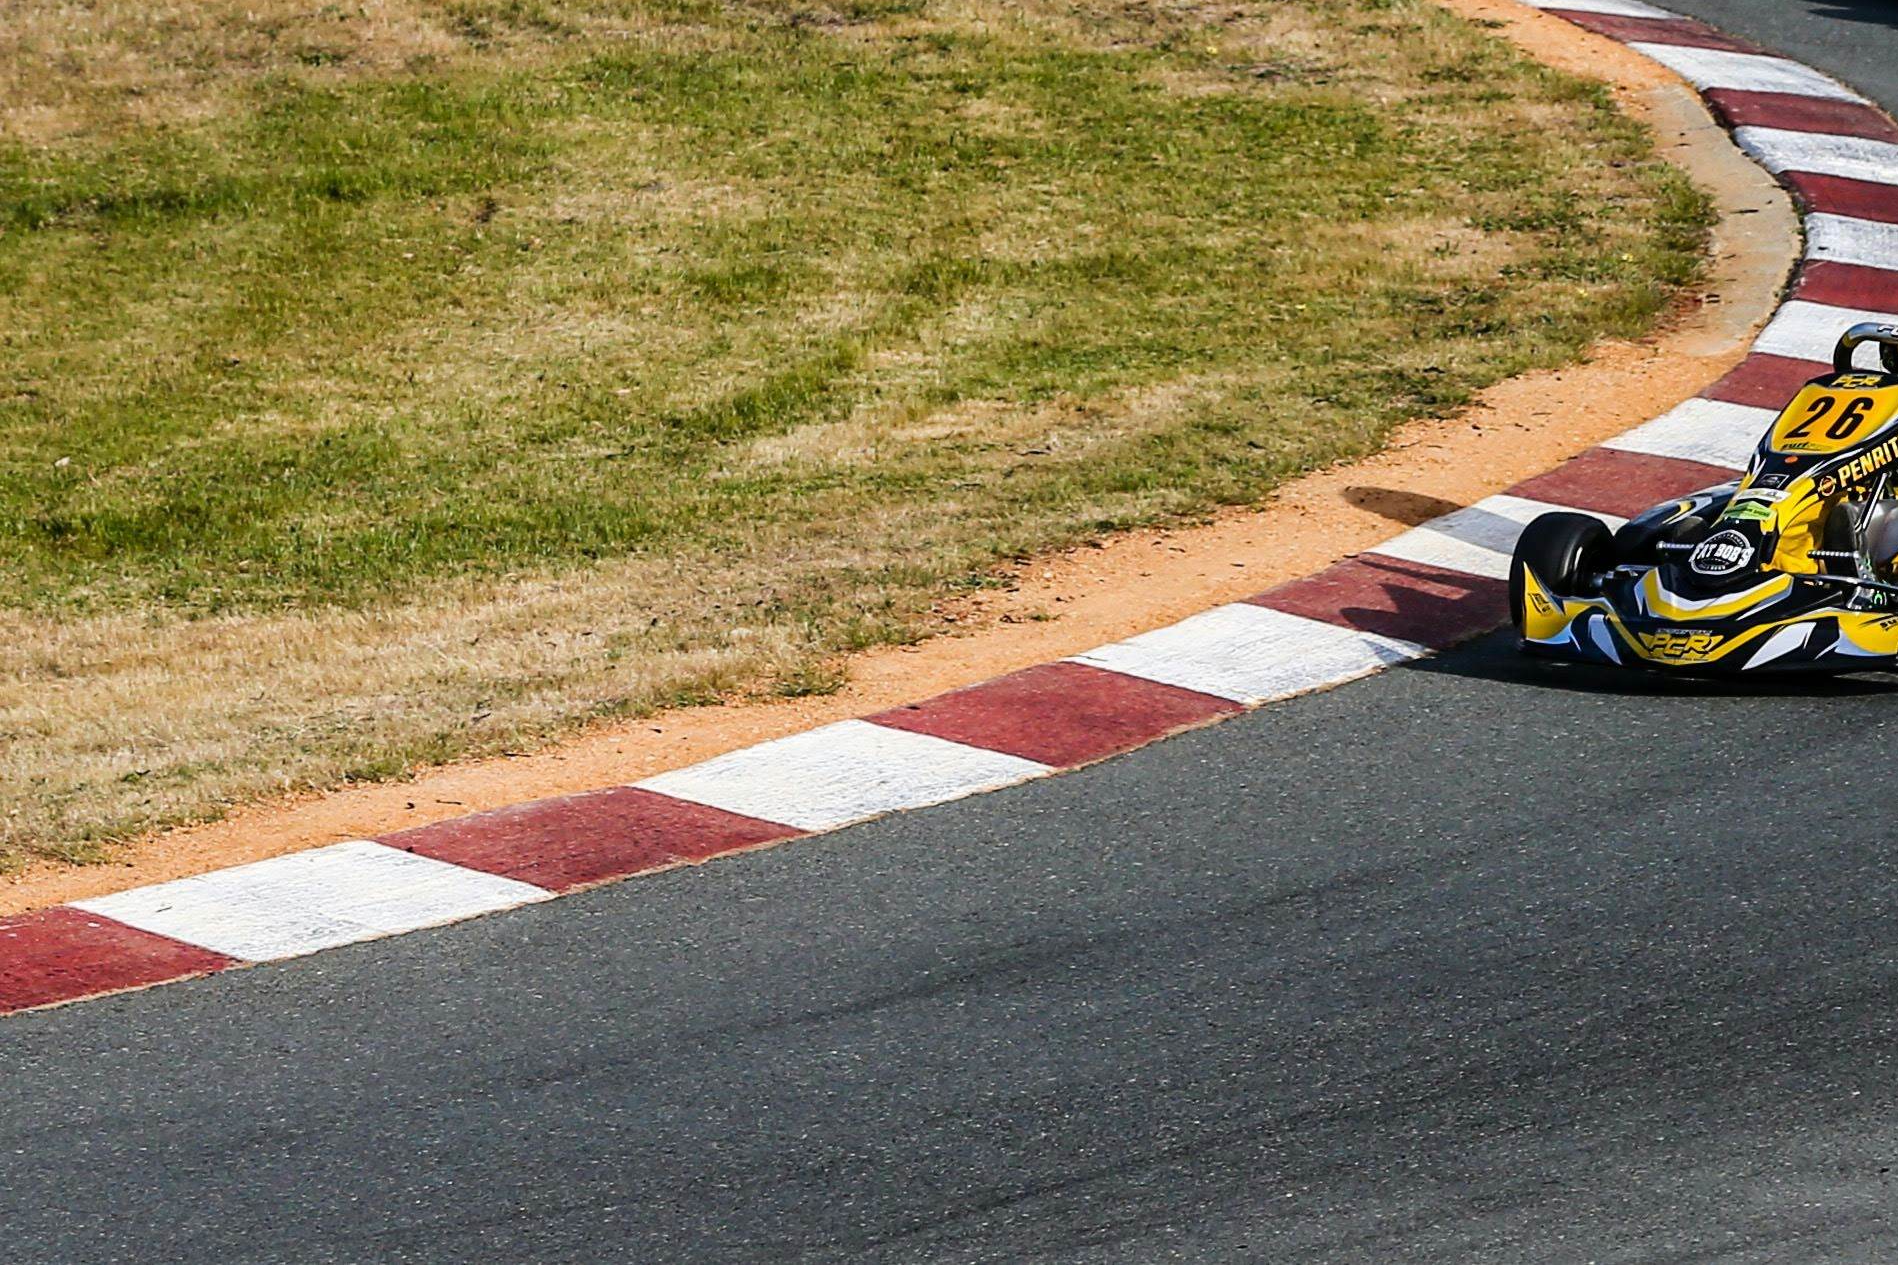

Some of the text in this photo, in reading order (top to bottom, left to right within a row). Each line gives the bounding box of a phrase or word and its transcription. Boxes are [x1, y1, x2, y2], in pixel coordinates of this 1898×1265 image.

[1831, 374, 1882, 390] PCR
[1784, 396, 1874, 440] 26
[1714, 543, 1756, 568] BOB'S
[1648, 632, 1712, 656] PCR
